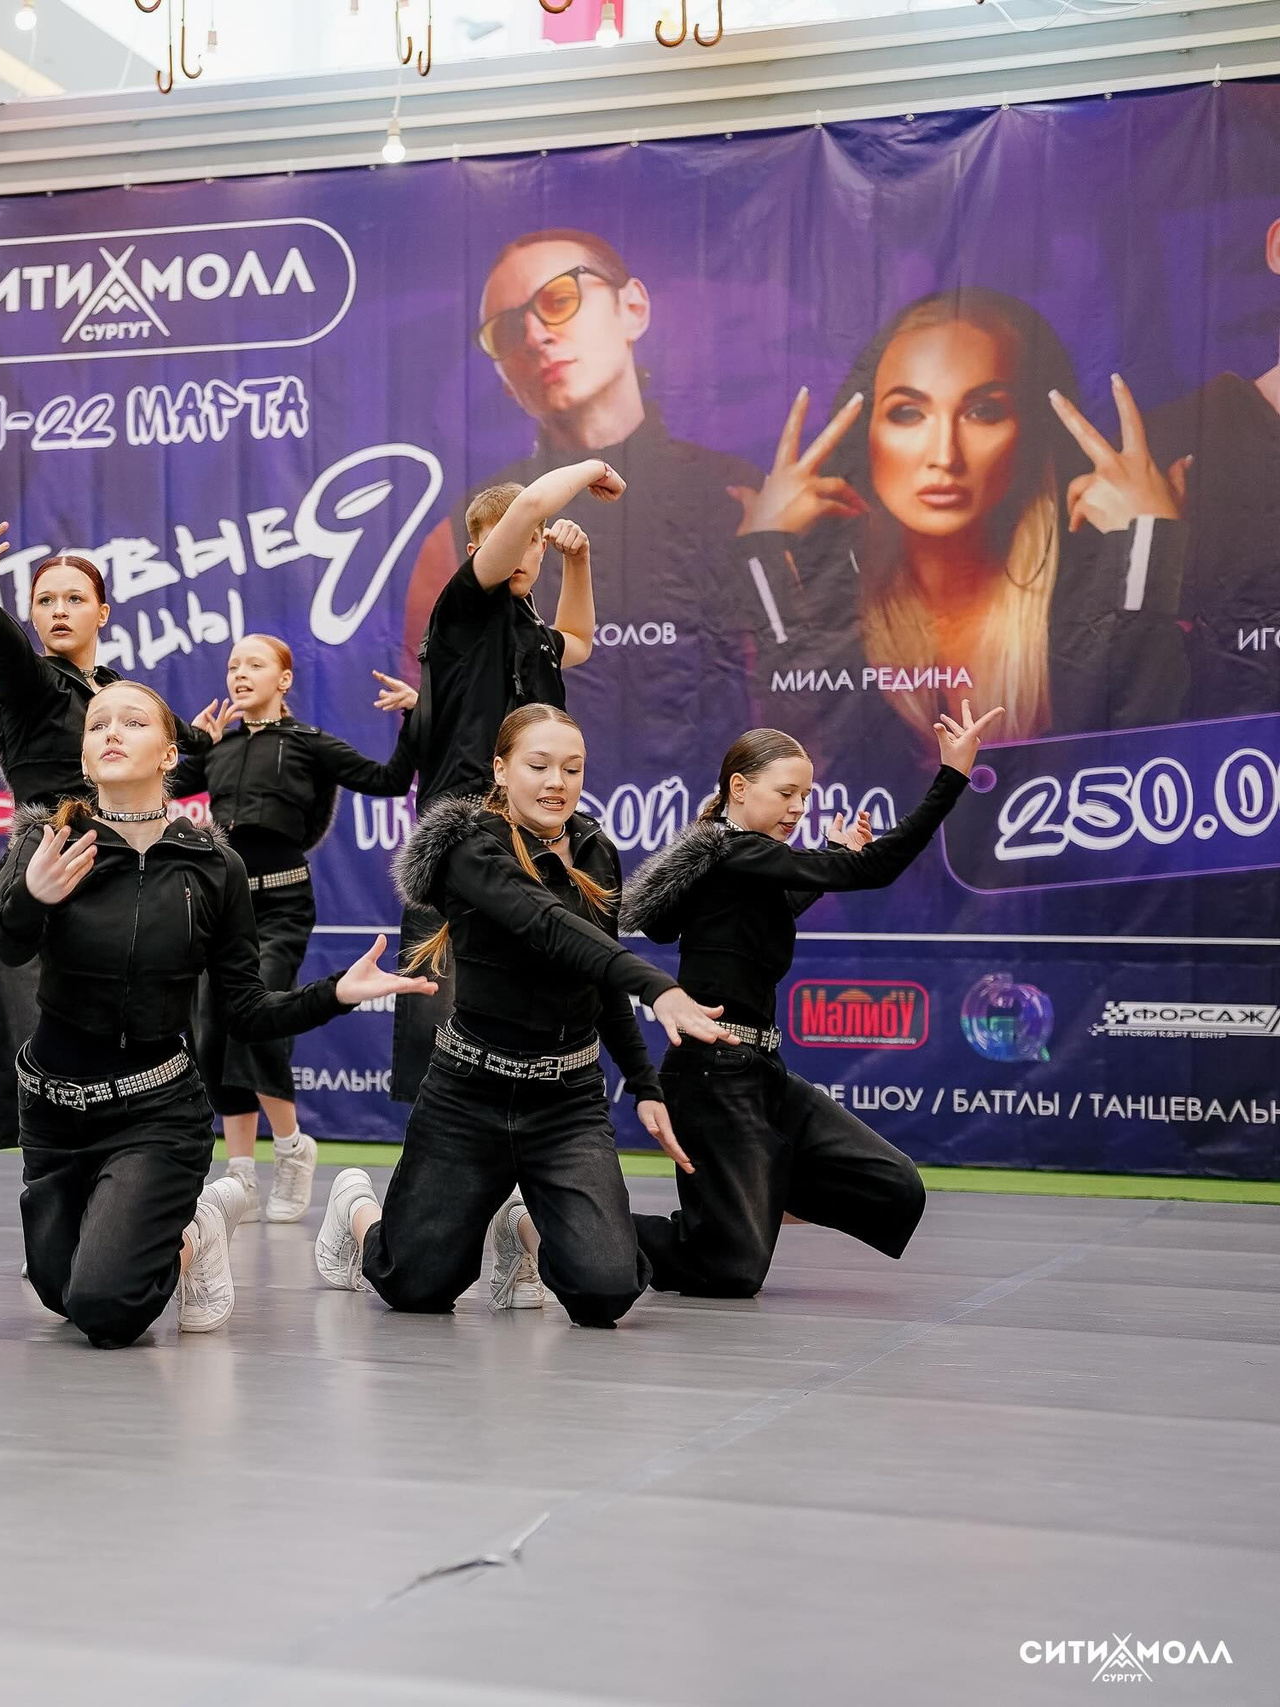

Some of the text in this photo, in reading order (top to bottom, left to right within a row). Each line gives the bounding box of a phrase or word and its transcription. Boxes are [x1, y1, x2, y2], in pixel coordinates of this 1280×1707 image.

[140, 246, 316, 302] МОЛЛ
[79, 320, 153, 342] СУРГУТ
[126, 375, 309, 446] МАРТА
[1238, 627, 1280, 651] ИГ
[771, 665, 973, 692] МИЛА РЕДИНА
[1132, 1008, 1267, 1026] ФОРСАЖ
[852, 1085, 924, 1112] ШОУ
[952, 1088, 1060, 1117] БАТТЛЫ
